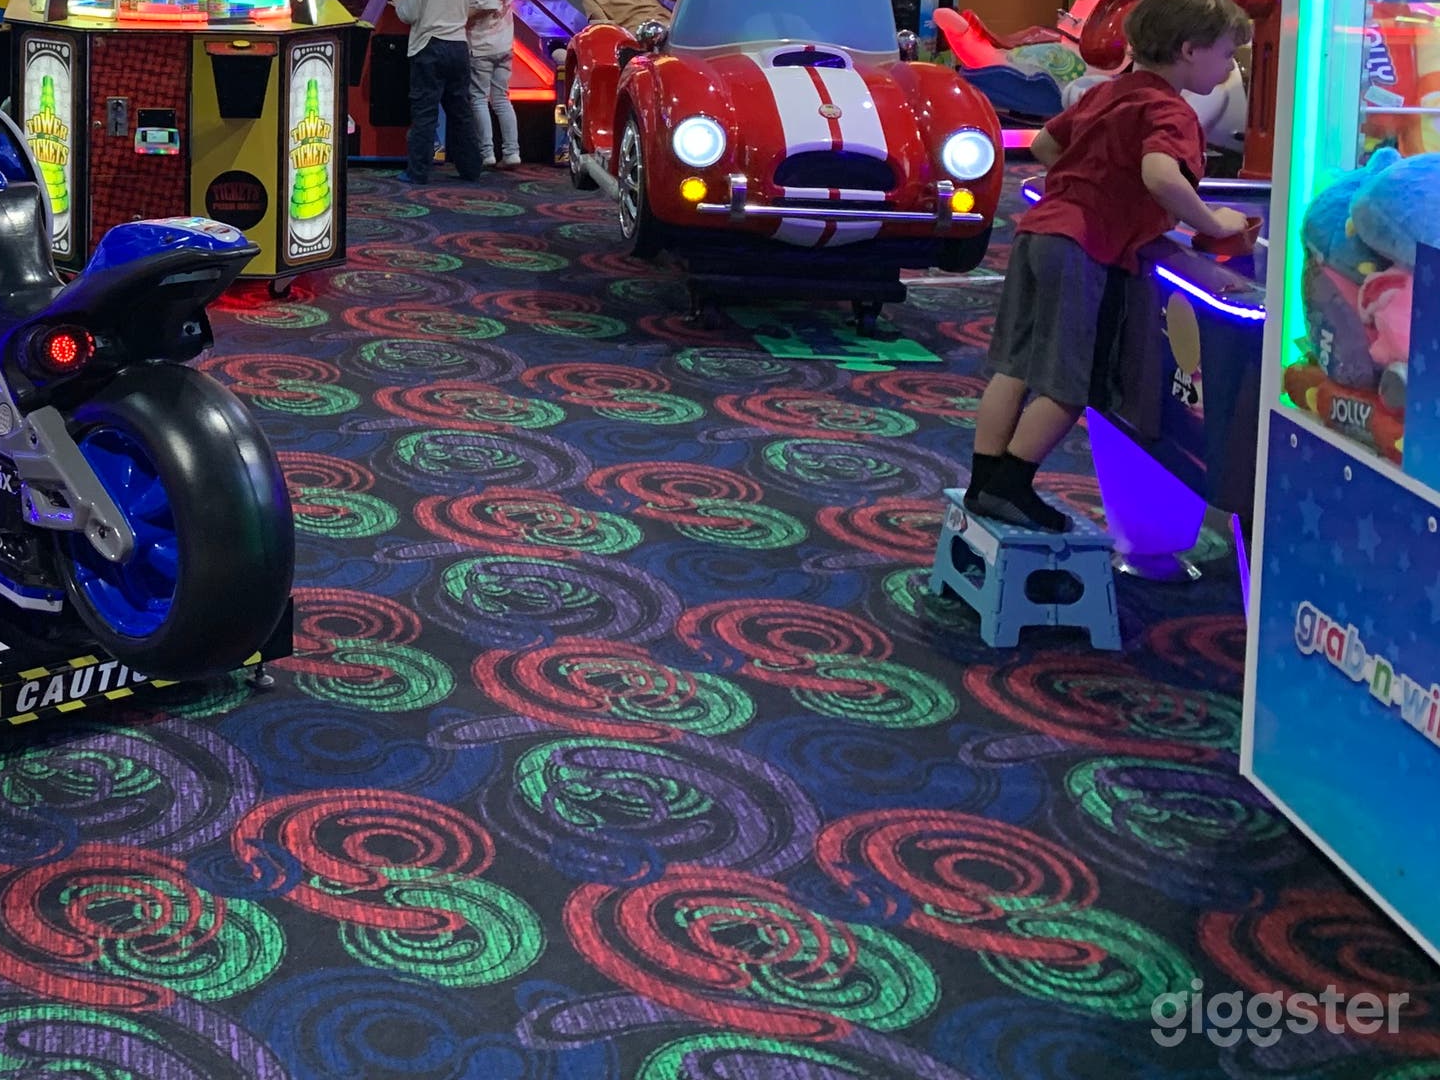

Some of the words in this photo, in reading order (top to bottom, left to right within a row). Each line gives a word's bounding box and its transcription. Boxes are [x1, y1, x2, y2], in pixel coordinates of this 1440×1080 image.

[27, 108, 68, 141] TOWER
[291, 111, 330, 142] TOWER
[291, 142, 332, 170] TICKETS
[1330, 397, 1372, 428] JOLLY
